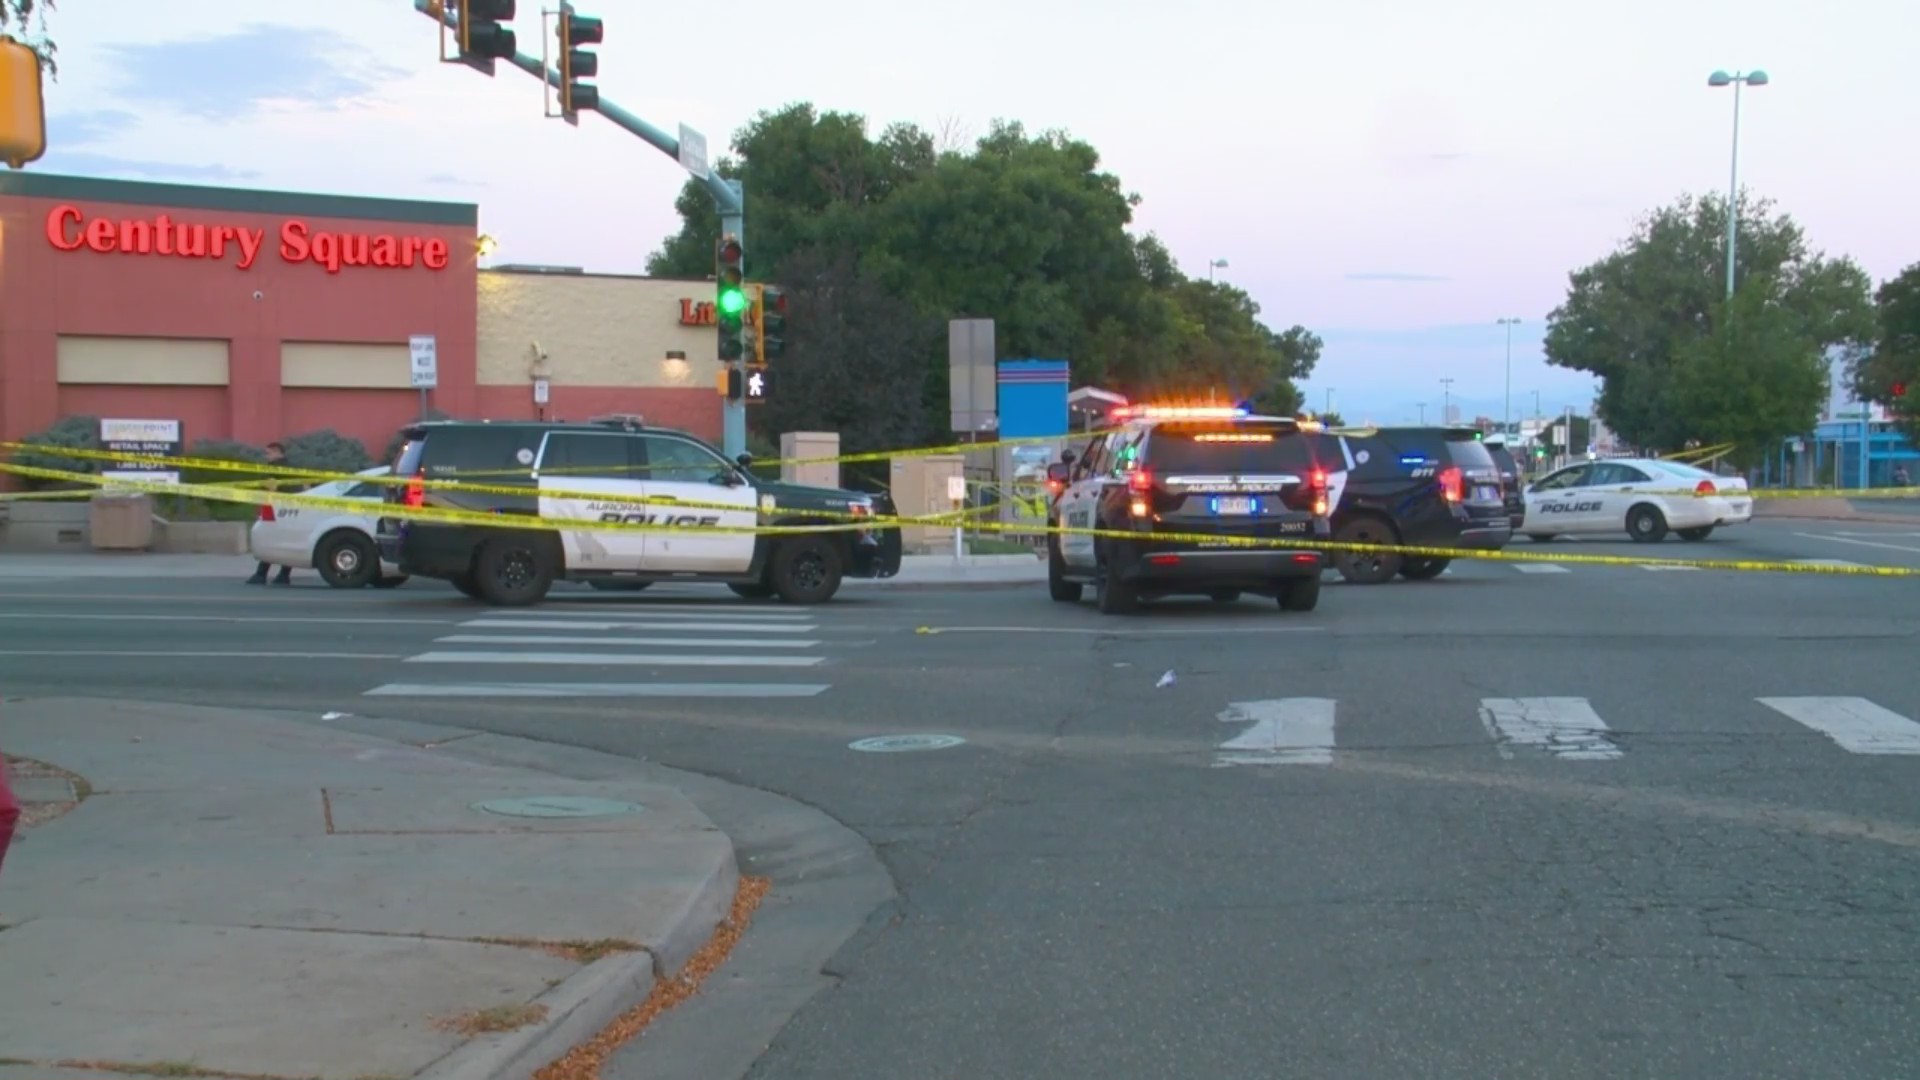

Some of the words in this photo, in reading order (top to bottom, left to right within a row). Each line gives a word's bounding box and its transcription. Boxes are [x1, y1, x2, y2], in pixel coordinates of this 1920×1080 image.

[46, 204, 264, 269] Century
[280, 219, 449, 274] Square
[1410, 467, 1435, 478] 911
[1186, 483, 1238, 493] AURORA
[1241, 483, 1282, 493] POLICE
[586, 500, 642, 512] AURORA
[1539, 501, 1604, 514] POLICE
